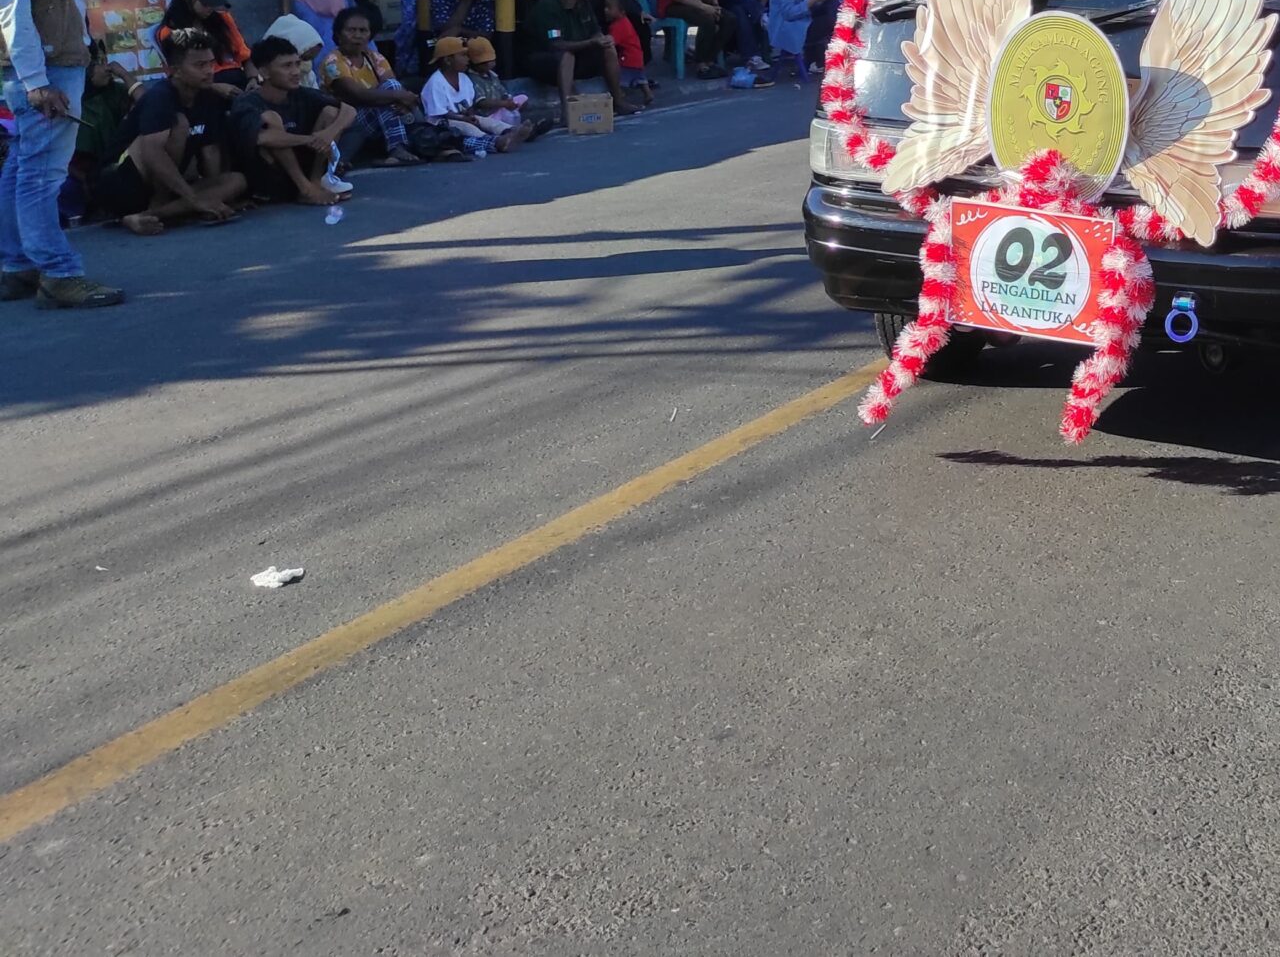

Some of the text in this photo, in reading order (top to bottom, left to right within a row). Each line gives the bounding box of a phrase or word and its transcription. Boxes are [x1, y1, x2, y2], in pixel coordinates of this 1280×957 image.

[1008, 31, 1109, 104] MAHKAMAH AGUNG
[994, 227, 1073, 290] 02
[981, 281, 1077, 305] PENGADILAN
[981, 301, 1075, 325] LARANTUKA
